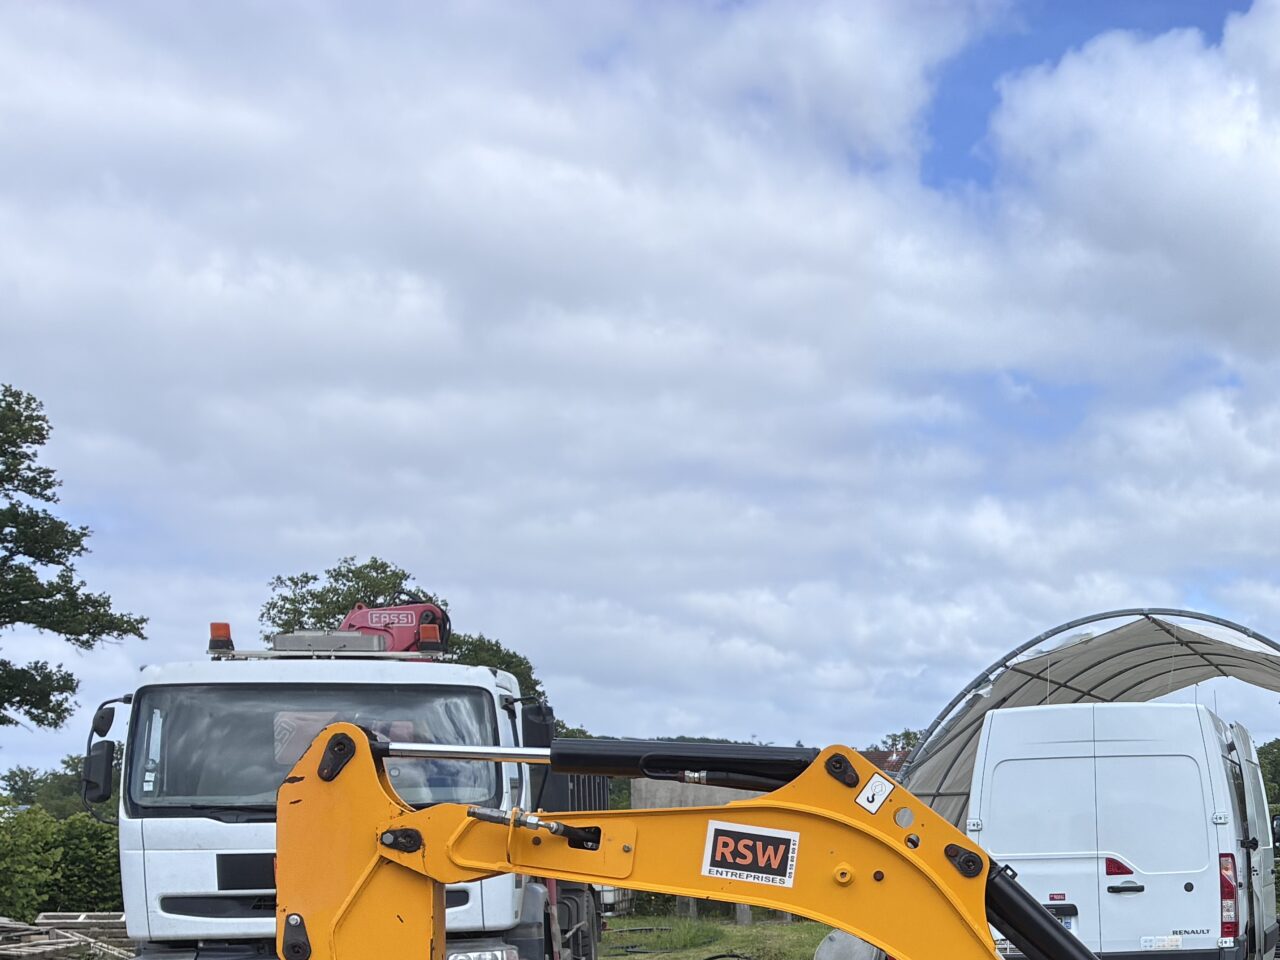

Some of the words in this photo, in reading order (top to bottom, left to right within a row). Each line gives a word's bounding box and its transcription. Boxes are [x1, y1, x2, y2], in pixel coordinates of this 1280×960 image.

[371, 613, 412, 624] FASSI
[714, 835, 786, 869] RSW
[708, 868, 786, 885] ENTREPRISES
